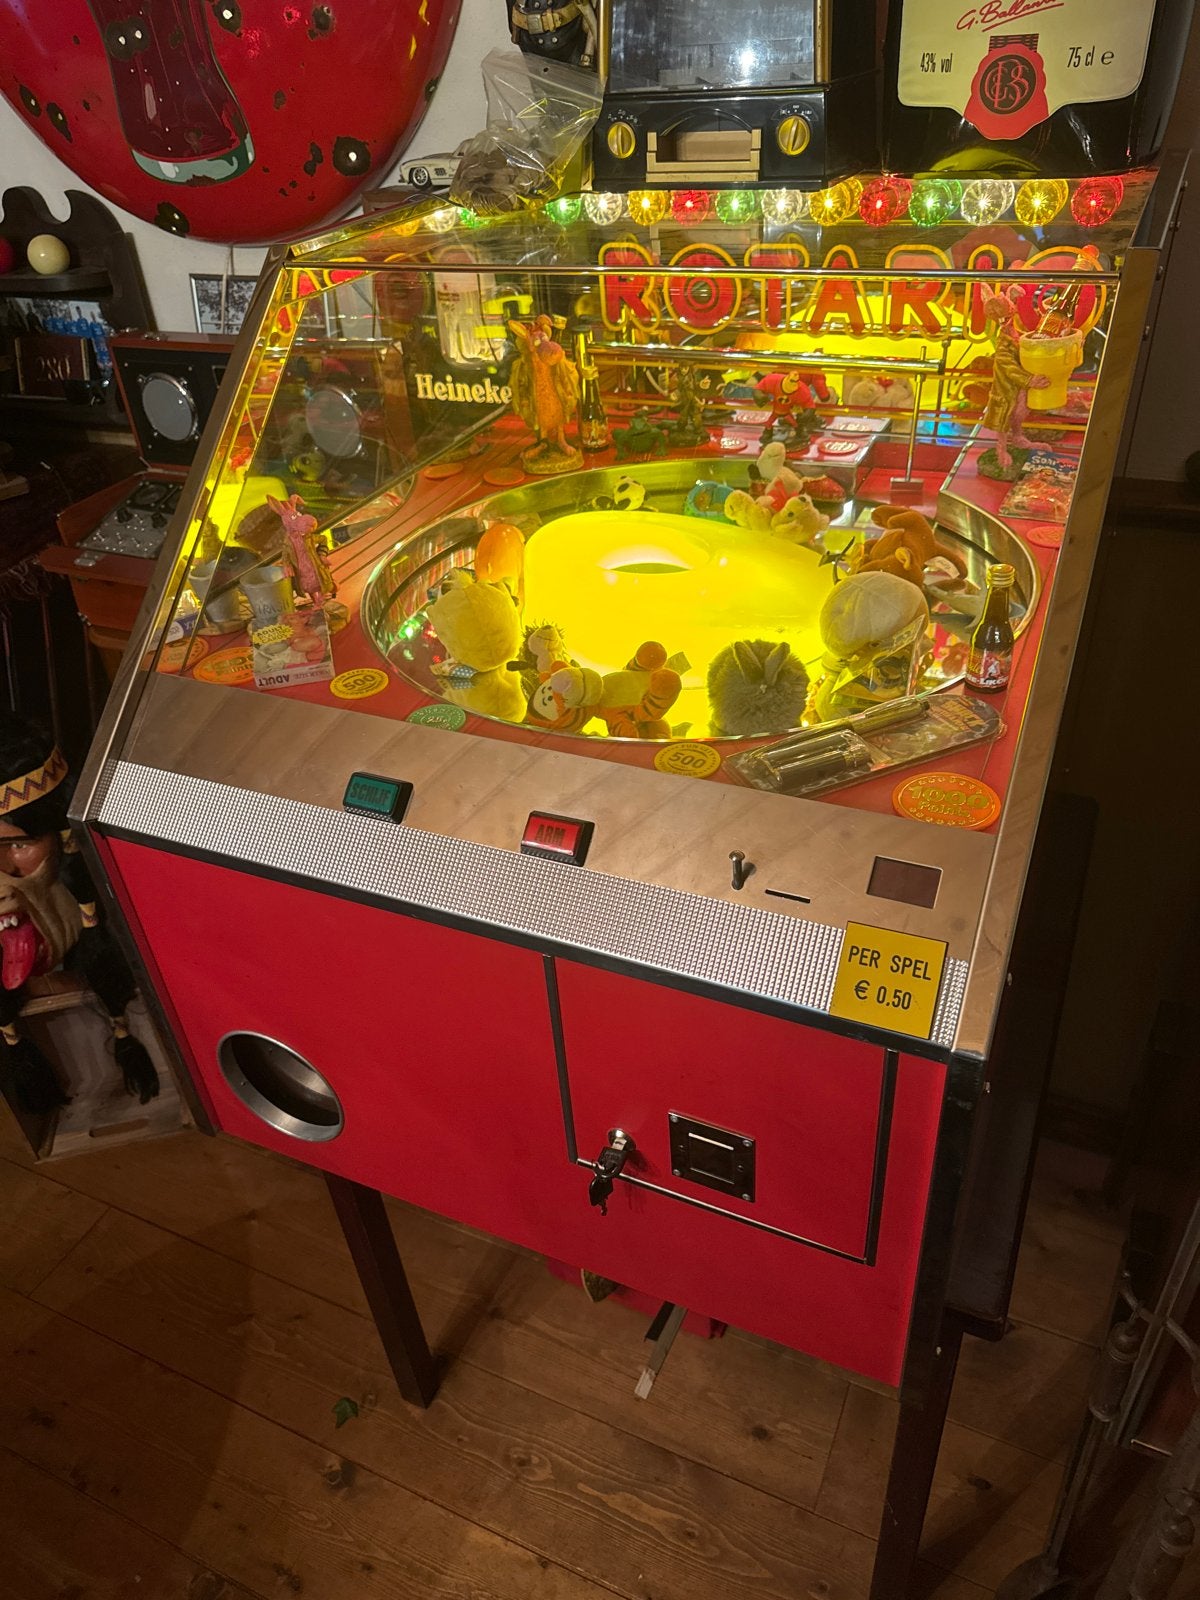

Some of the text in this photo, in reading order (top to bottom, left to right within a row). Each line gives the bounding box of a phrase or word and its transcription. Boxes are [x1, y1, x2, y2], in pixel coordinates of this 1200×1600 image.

[920, 52, 953, 73] 43% vol
[1066, 47, 1082, 68] 75
[1085, 46, 1095, 66] cl
[598, 243, 1108, 342] ROTARIO
[414, 373, 513, 404] Heineke
[256, 623, 285, 638] ADULT
[258, 673, 290, 687] ADULT
[343, 674, 376, 691] 500
[668, 752, 706, 769] 500
[352, 781, 392, 805] SCHIJF
[908, 785, 990, 809] 1000
[919, 799, 972, 818] Points
[535, 823, 567, 845] ARM
[848, 945, 931, 981] PER SPEL
[854, 980, 912, 1010] € 0.50
